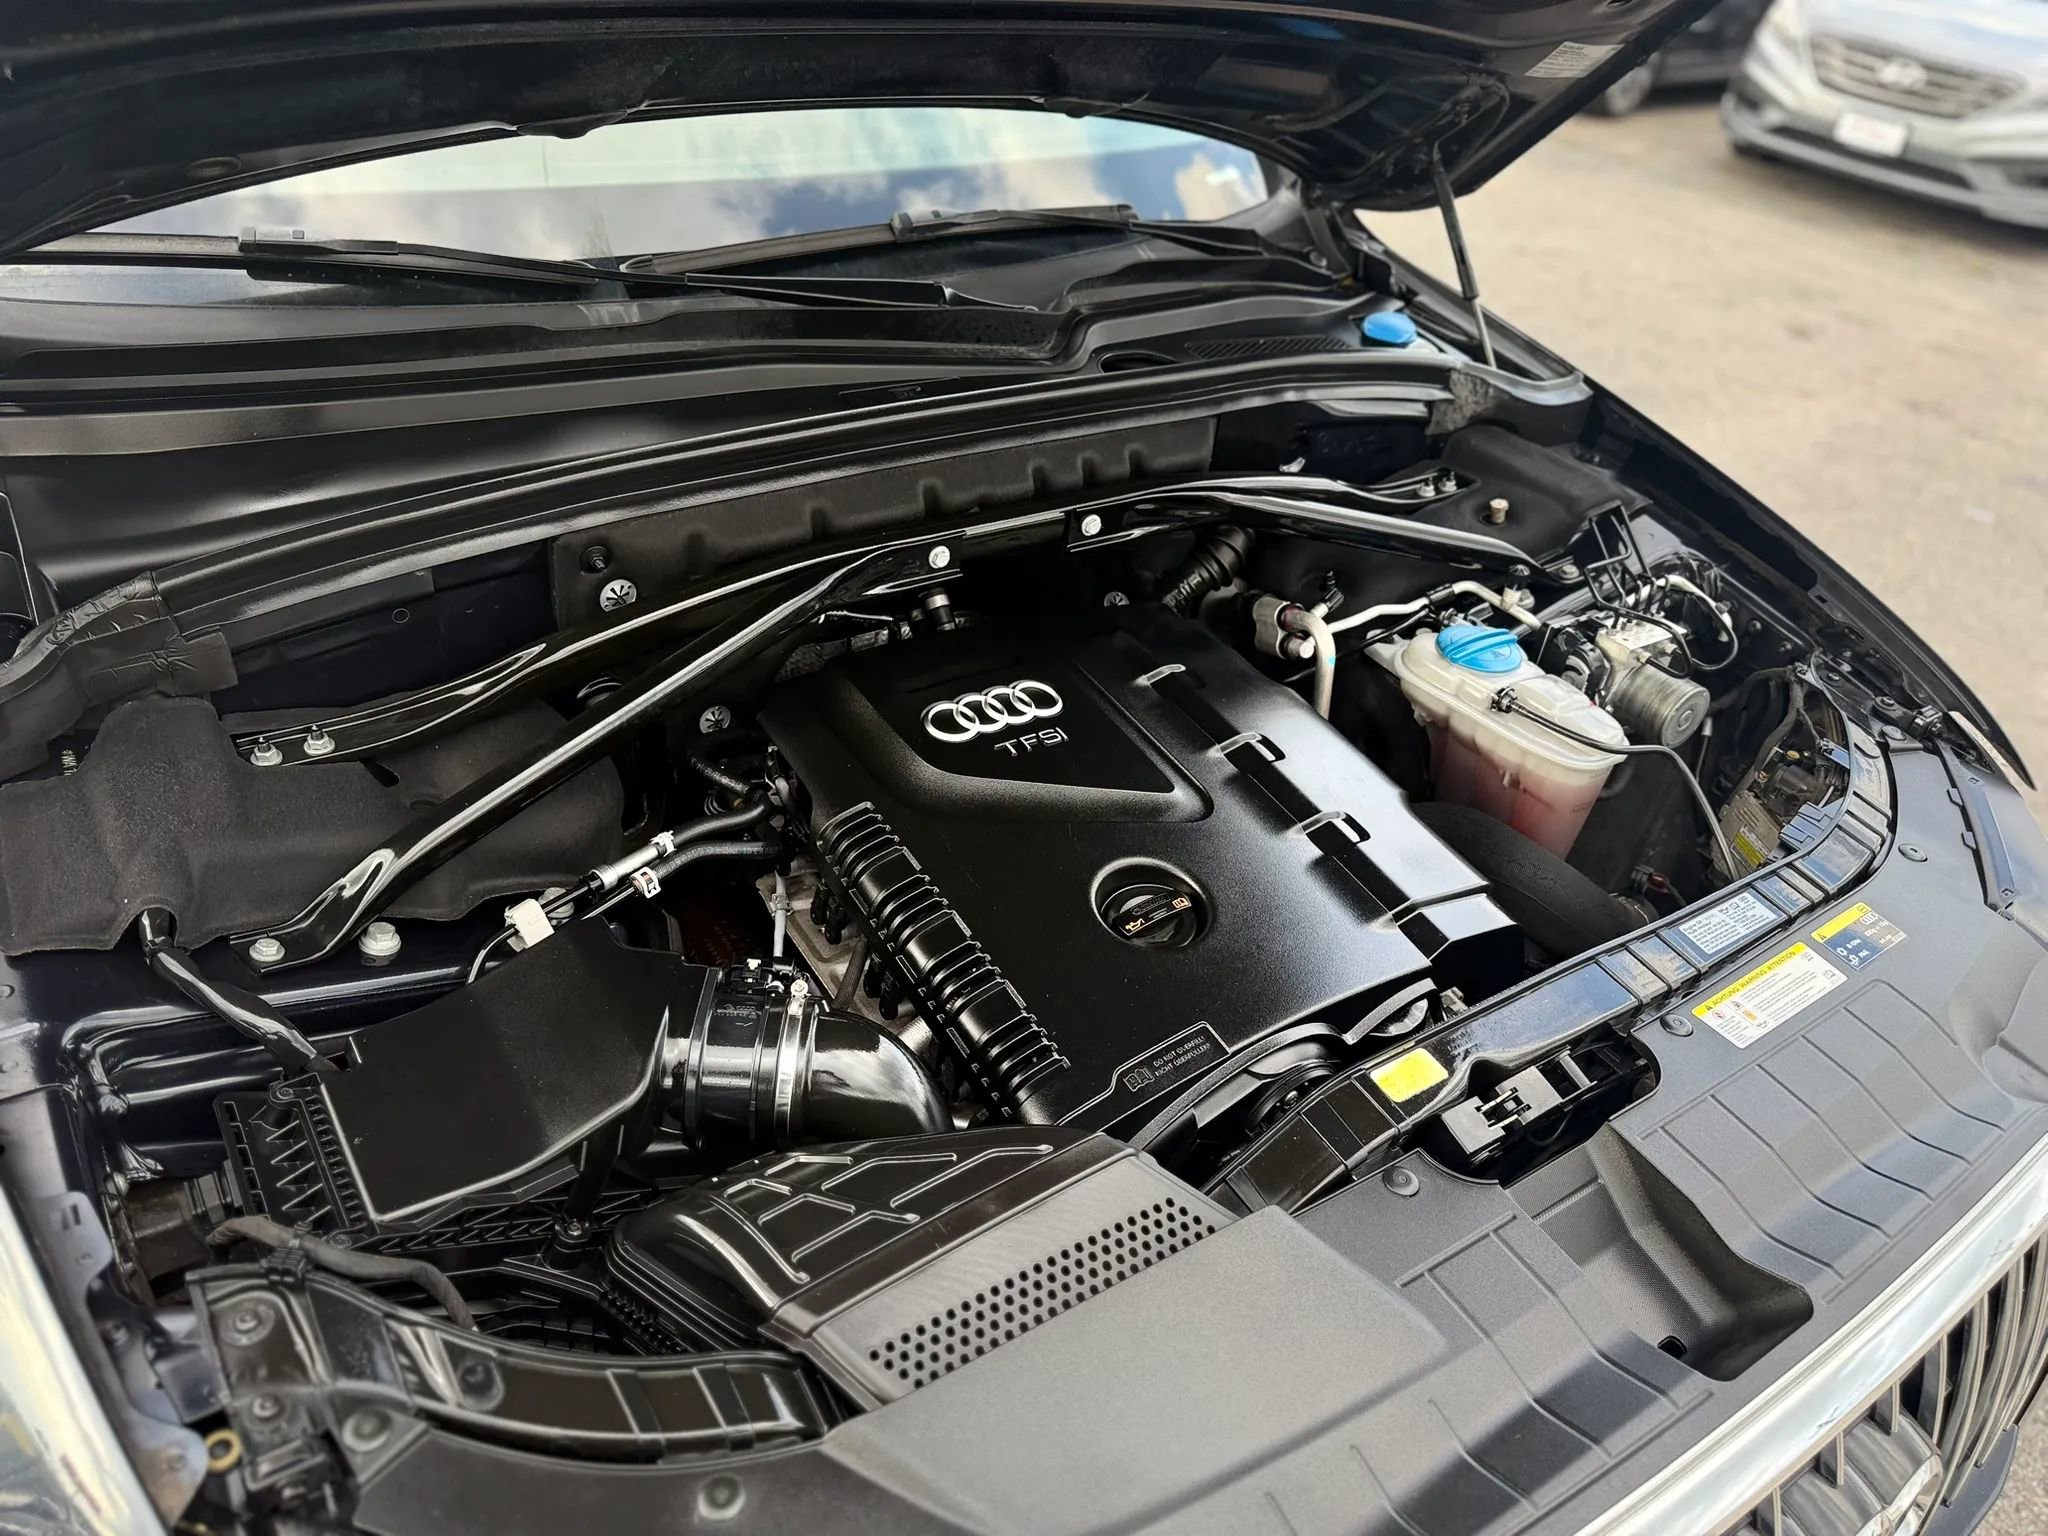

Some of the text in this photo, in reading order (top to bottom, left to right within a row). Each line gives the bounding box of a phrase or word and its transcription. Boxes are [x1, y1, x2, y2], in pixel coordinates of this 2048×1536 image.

[994, 727, 1069, 757] TFSI
[1712, 951, 1796, 1006] ACHTUNG WARNING ATTENTION
[1153, 1058, 1164, 1067] DO
[1163, 1050, 1177, 1062] NOT
